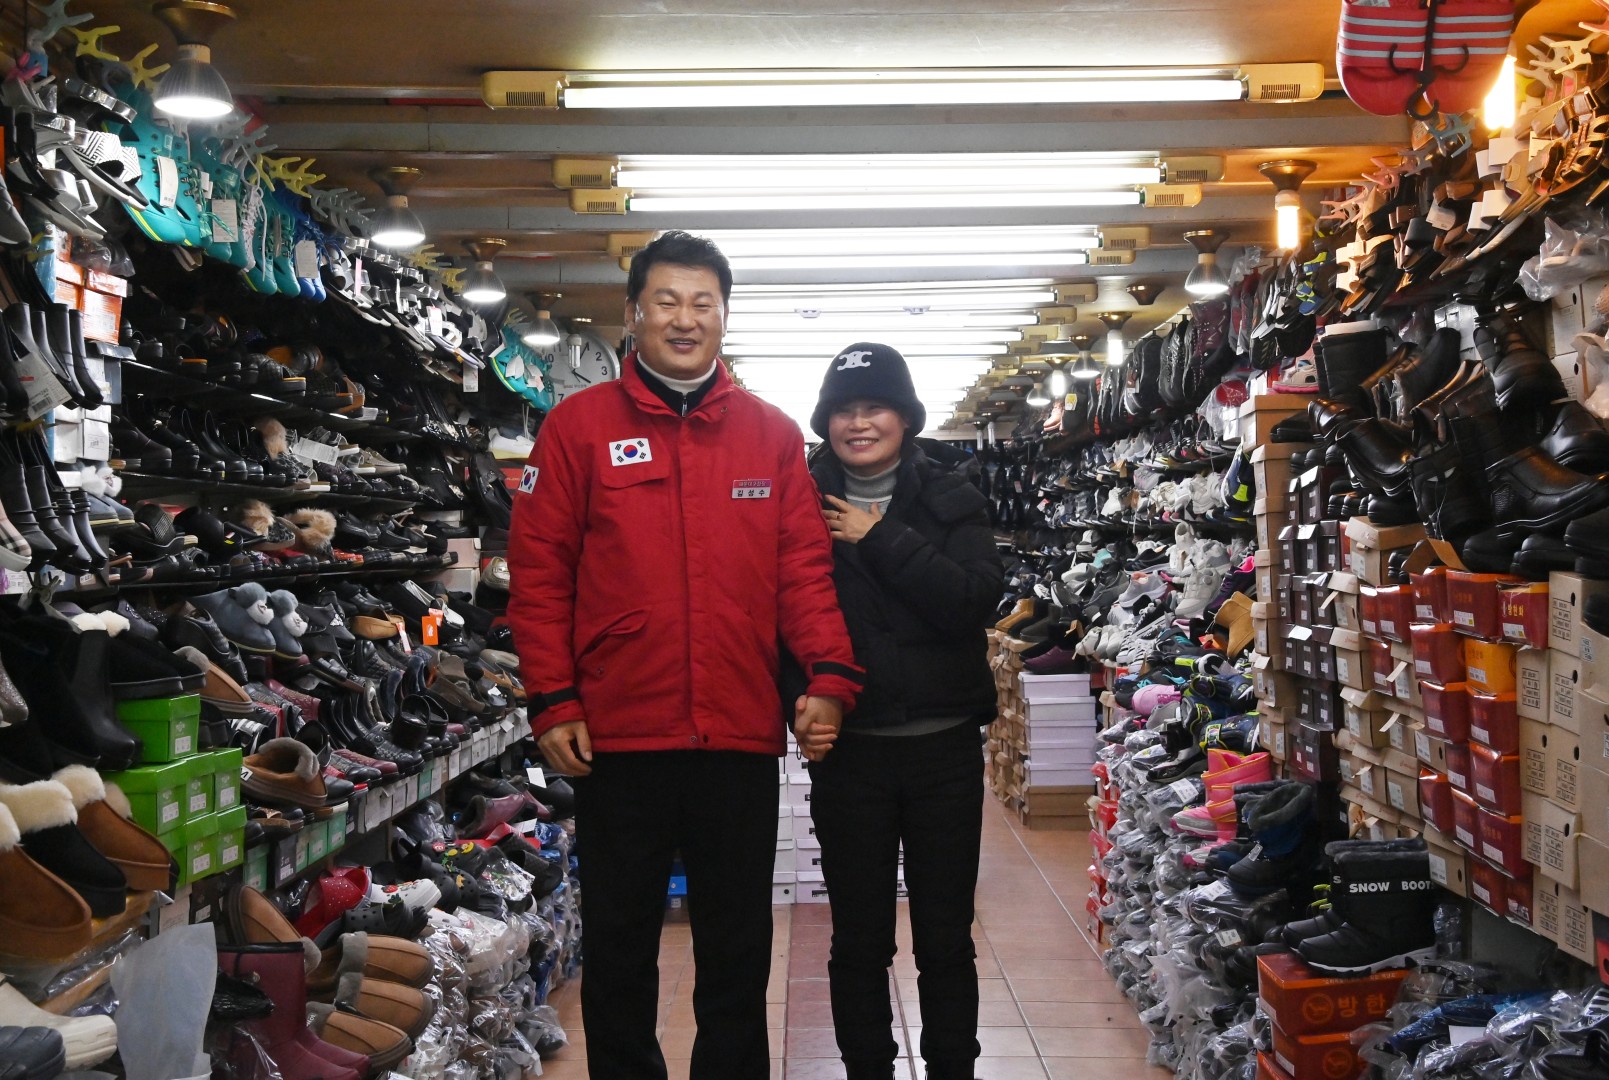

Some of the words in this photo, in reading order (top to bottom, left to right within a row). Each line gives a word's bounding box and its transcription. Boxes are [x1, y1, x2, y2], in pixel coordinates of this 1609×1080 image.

[596, 352, 602, 361] 2
[602, 366, 608, 375] 3
[558, 394, 564, 402] 7
[1349, 882, 1390, 893] SNOW
[1401, 881, 1434, 890] BOOT
